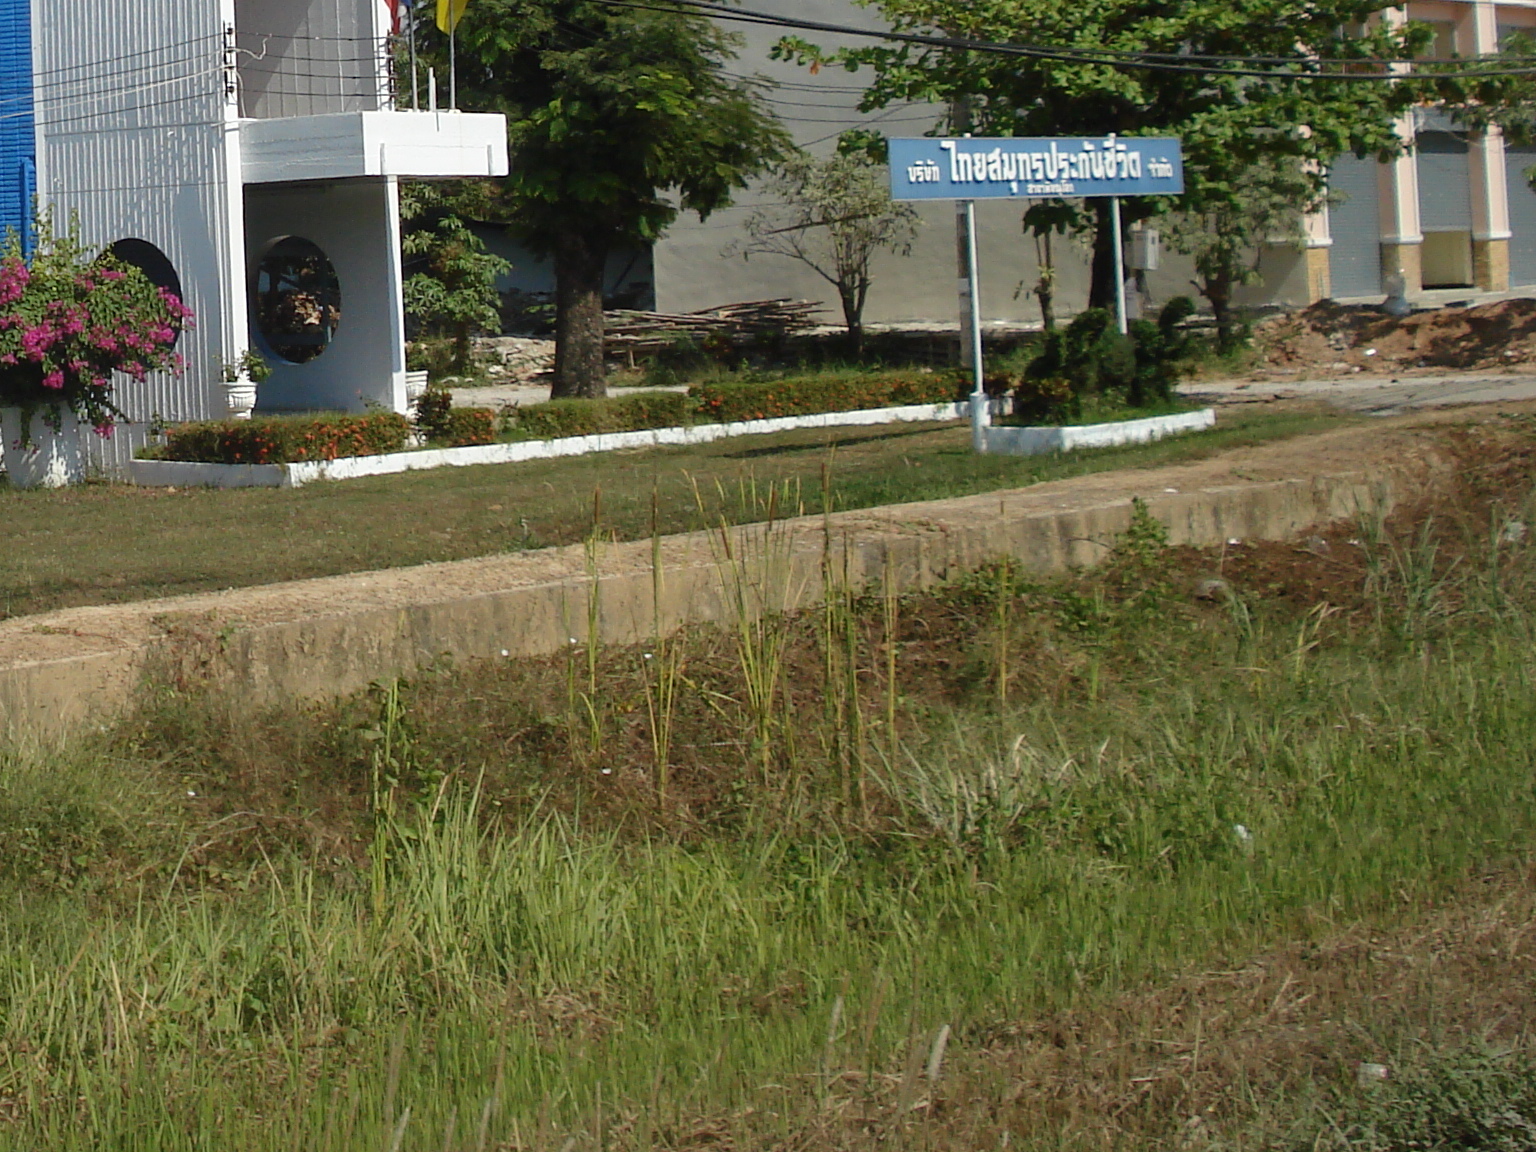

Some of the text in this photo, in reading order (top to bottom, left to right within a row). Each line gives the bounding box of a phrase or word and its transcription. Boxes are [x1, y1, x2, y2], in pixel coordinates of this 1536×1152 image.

[907, 158, 941, 183] บริษัท
[940, 139, 1142, 194] ไทยสมุทรประกันชีวิต
